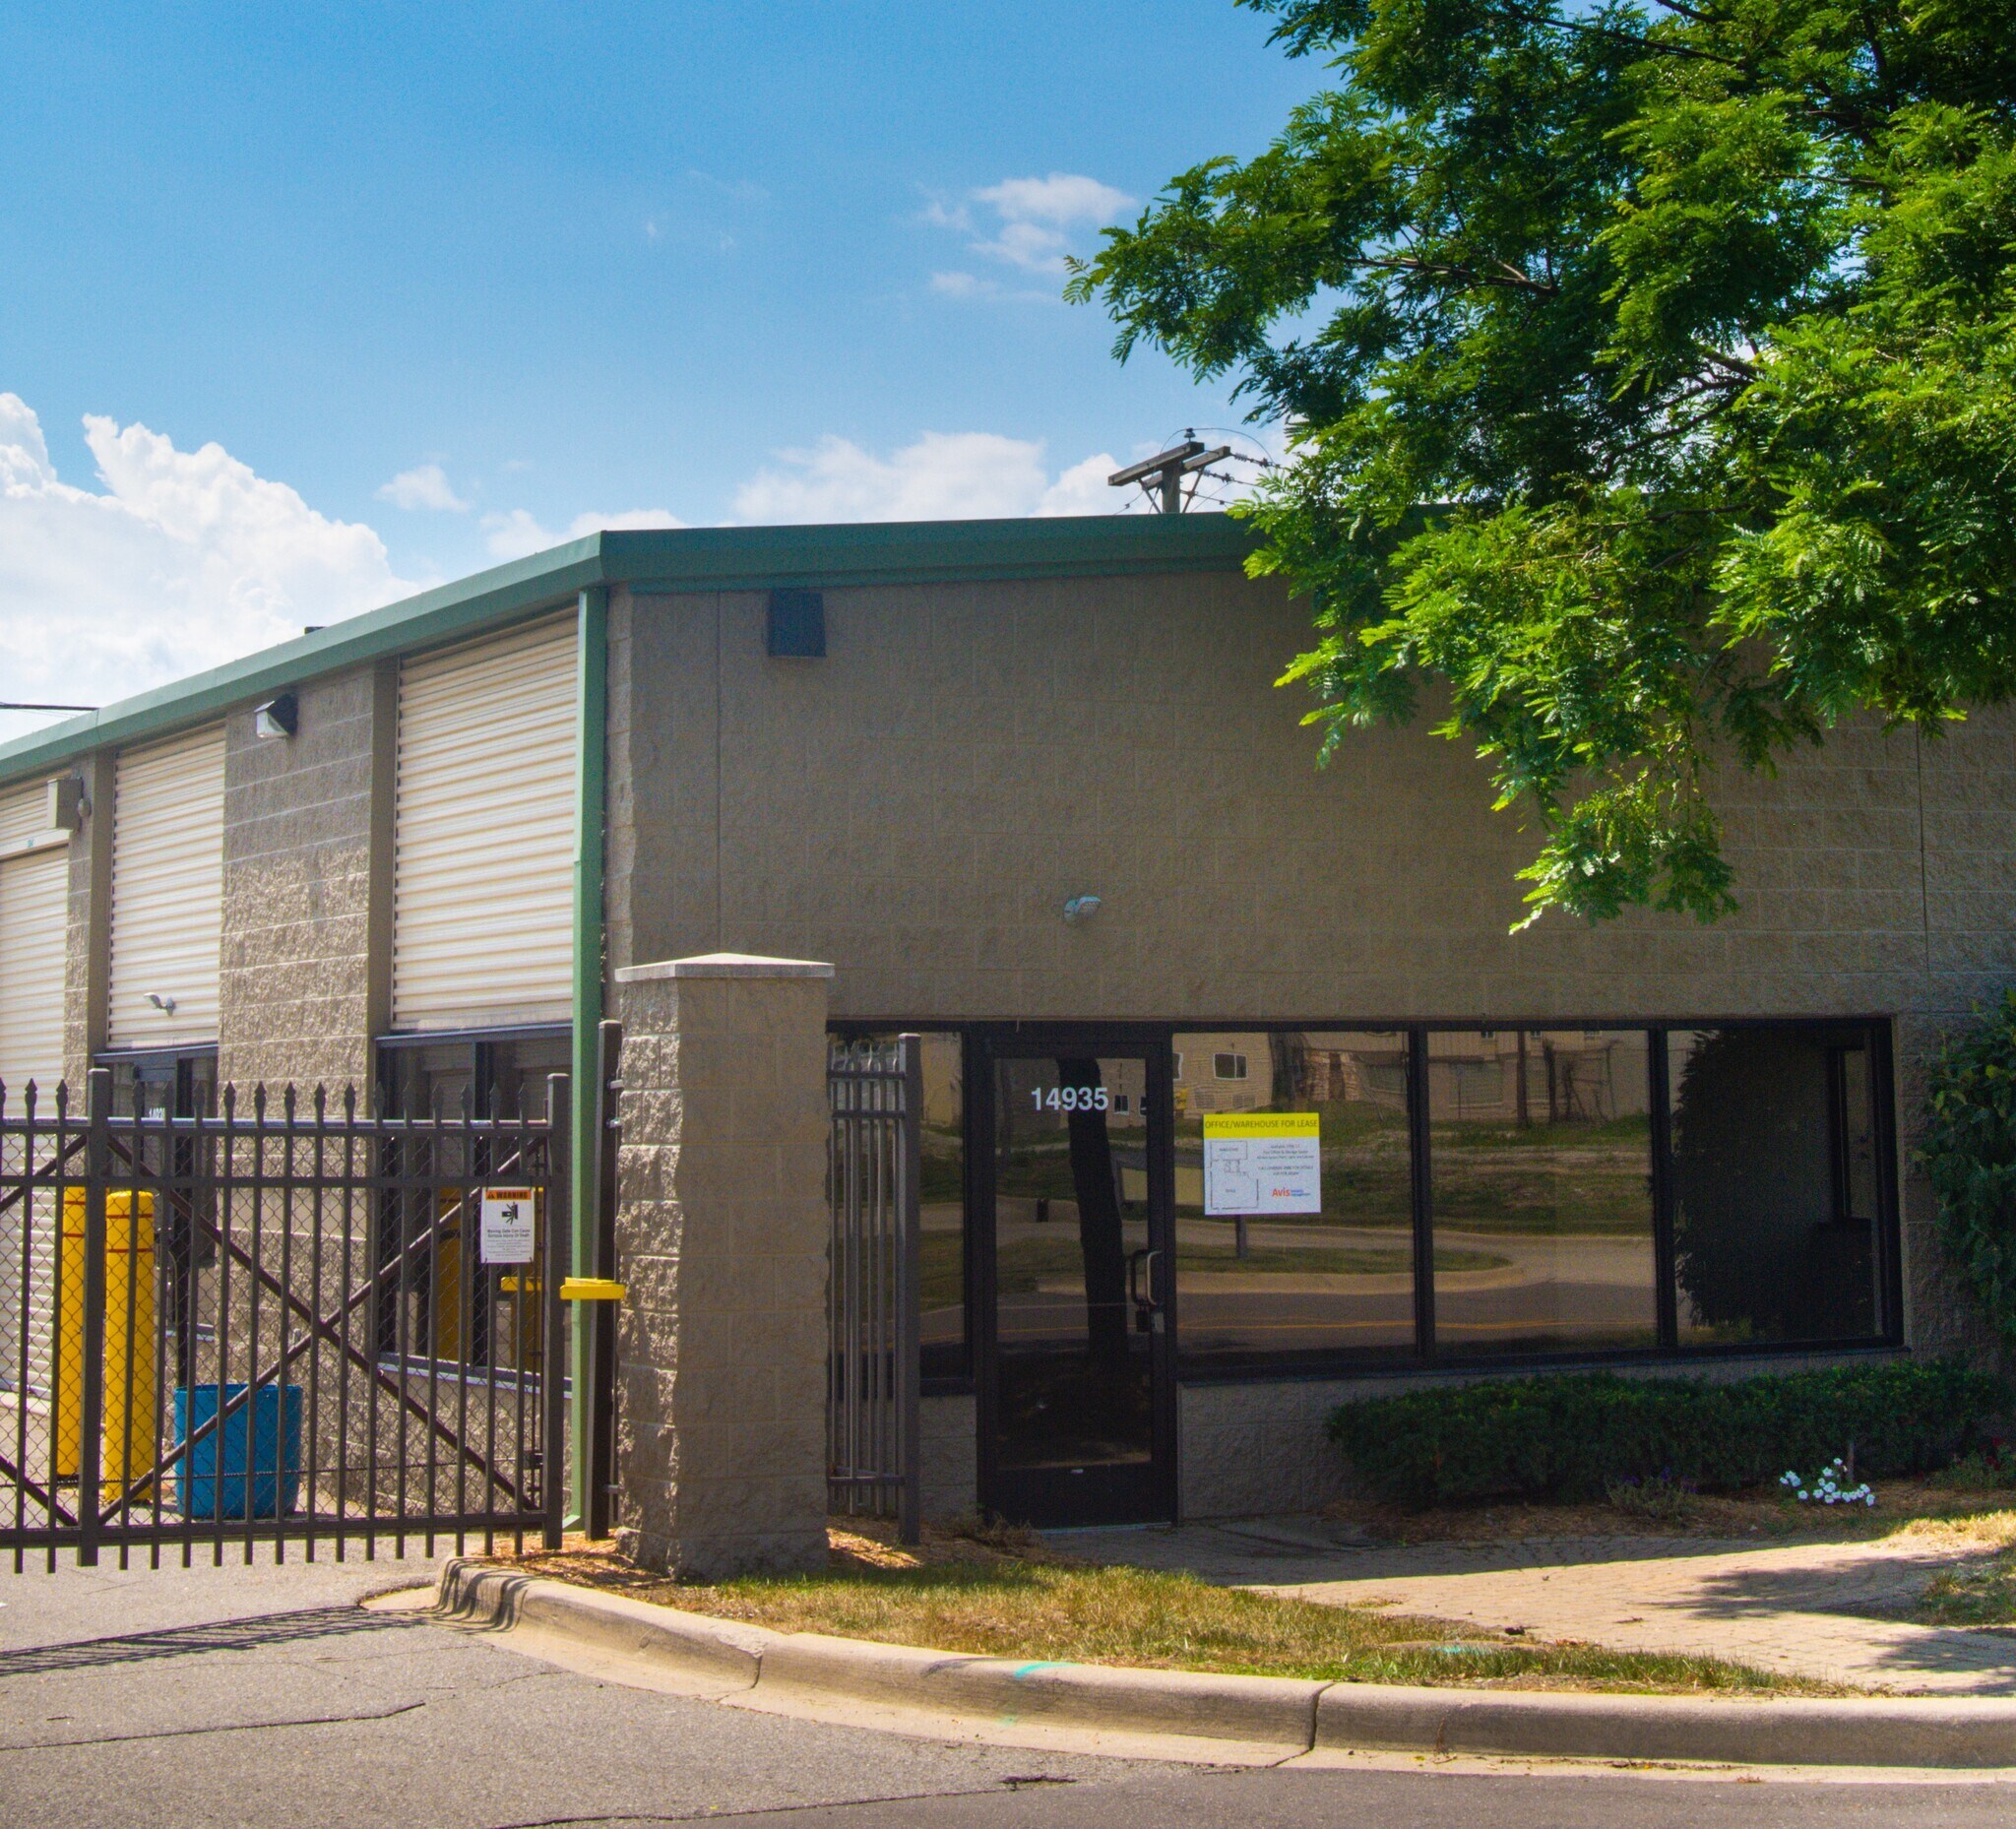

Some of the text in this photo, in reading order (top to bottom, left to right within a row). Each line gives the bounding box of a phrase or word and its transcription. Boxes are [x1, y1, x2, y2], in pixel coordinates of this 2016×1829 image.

[1031, 1087, 1108, 1111] 14935
[1205, 1119, 1279, 1129] OFFICE/WAREHOUSE
[1281, 1119, 1295, 1128] FOR
[496, 1190, 529, 1199] WARNING
[1272, 1186, 1291, 1197] Avis
